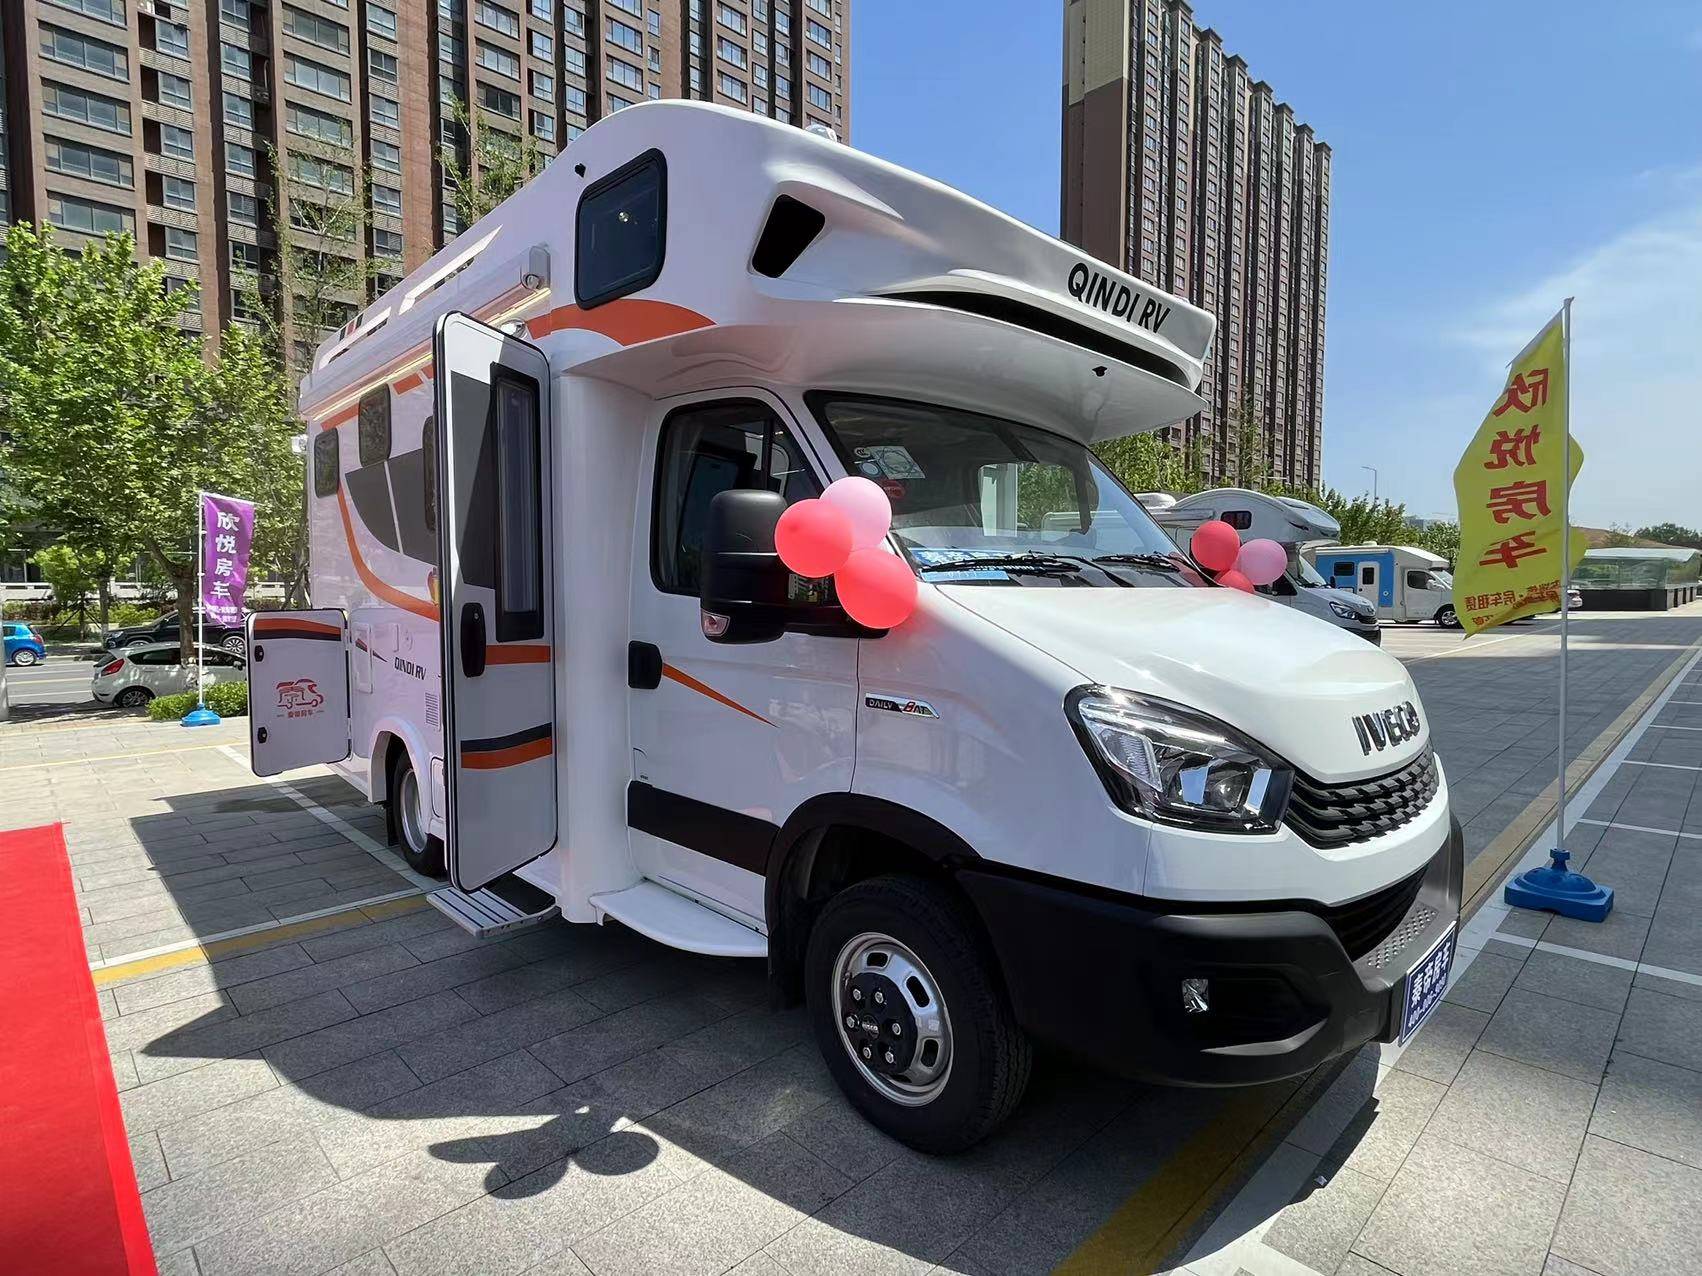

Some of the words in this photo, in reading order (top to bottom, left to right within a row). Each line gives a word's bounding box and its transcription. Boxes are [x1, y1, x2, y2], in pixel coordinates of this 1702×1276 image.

[1068, 262, 1141, 323] QINDI
[1138, 297, 1171, 334] RV
[210, 511, 241, 599] 欣悦房车
[394, 656, 415, 676] QINDI
[415, 665, 427, 680] RV
[869, 699, 894, 710] DAILY
[1352, 700, 1421, 756] IVECO
